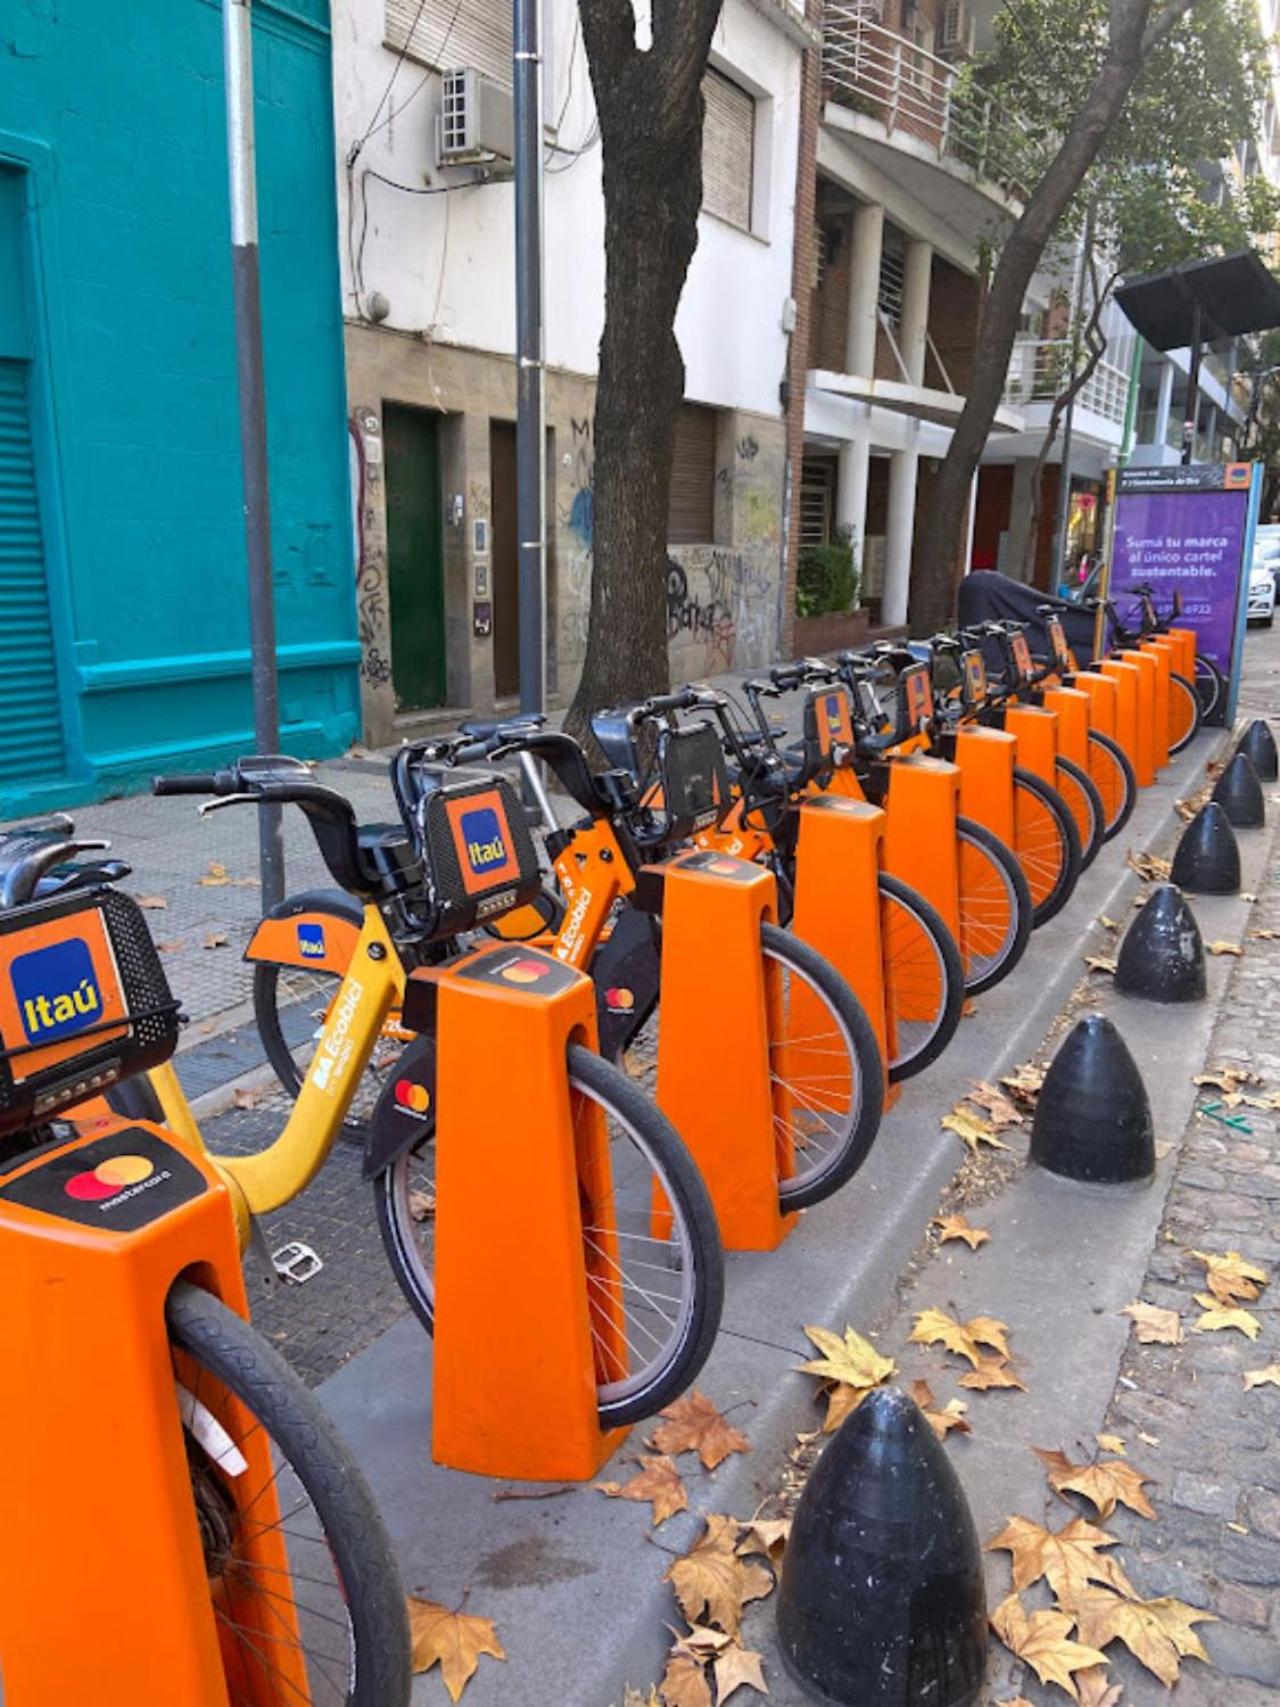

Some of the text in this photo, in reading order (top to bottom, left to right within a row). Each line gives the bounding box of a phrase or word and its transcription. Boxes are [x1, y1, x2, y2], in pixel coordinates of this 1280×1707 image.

[1128, 549, 1223, 563] al único cartel
[1166, 537, 1181, 547] tu
[1184, 537, 1228, 547] marca
[469, 834, 505, 865] Itaú
[562, 886, 592, 949] Ecobici
[24, 980, 98, 1032] Itaú
[312, 1057, 334, 1090] BA
[324, 977, 364, 1058] Ecobici
